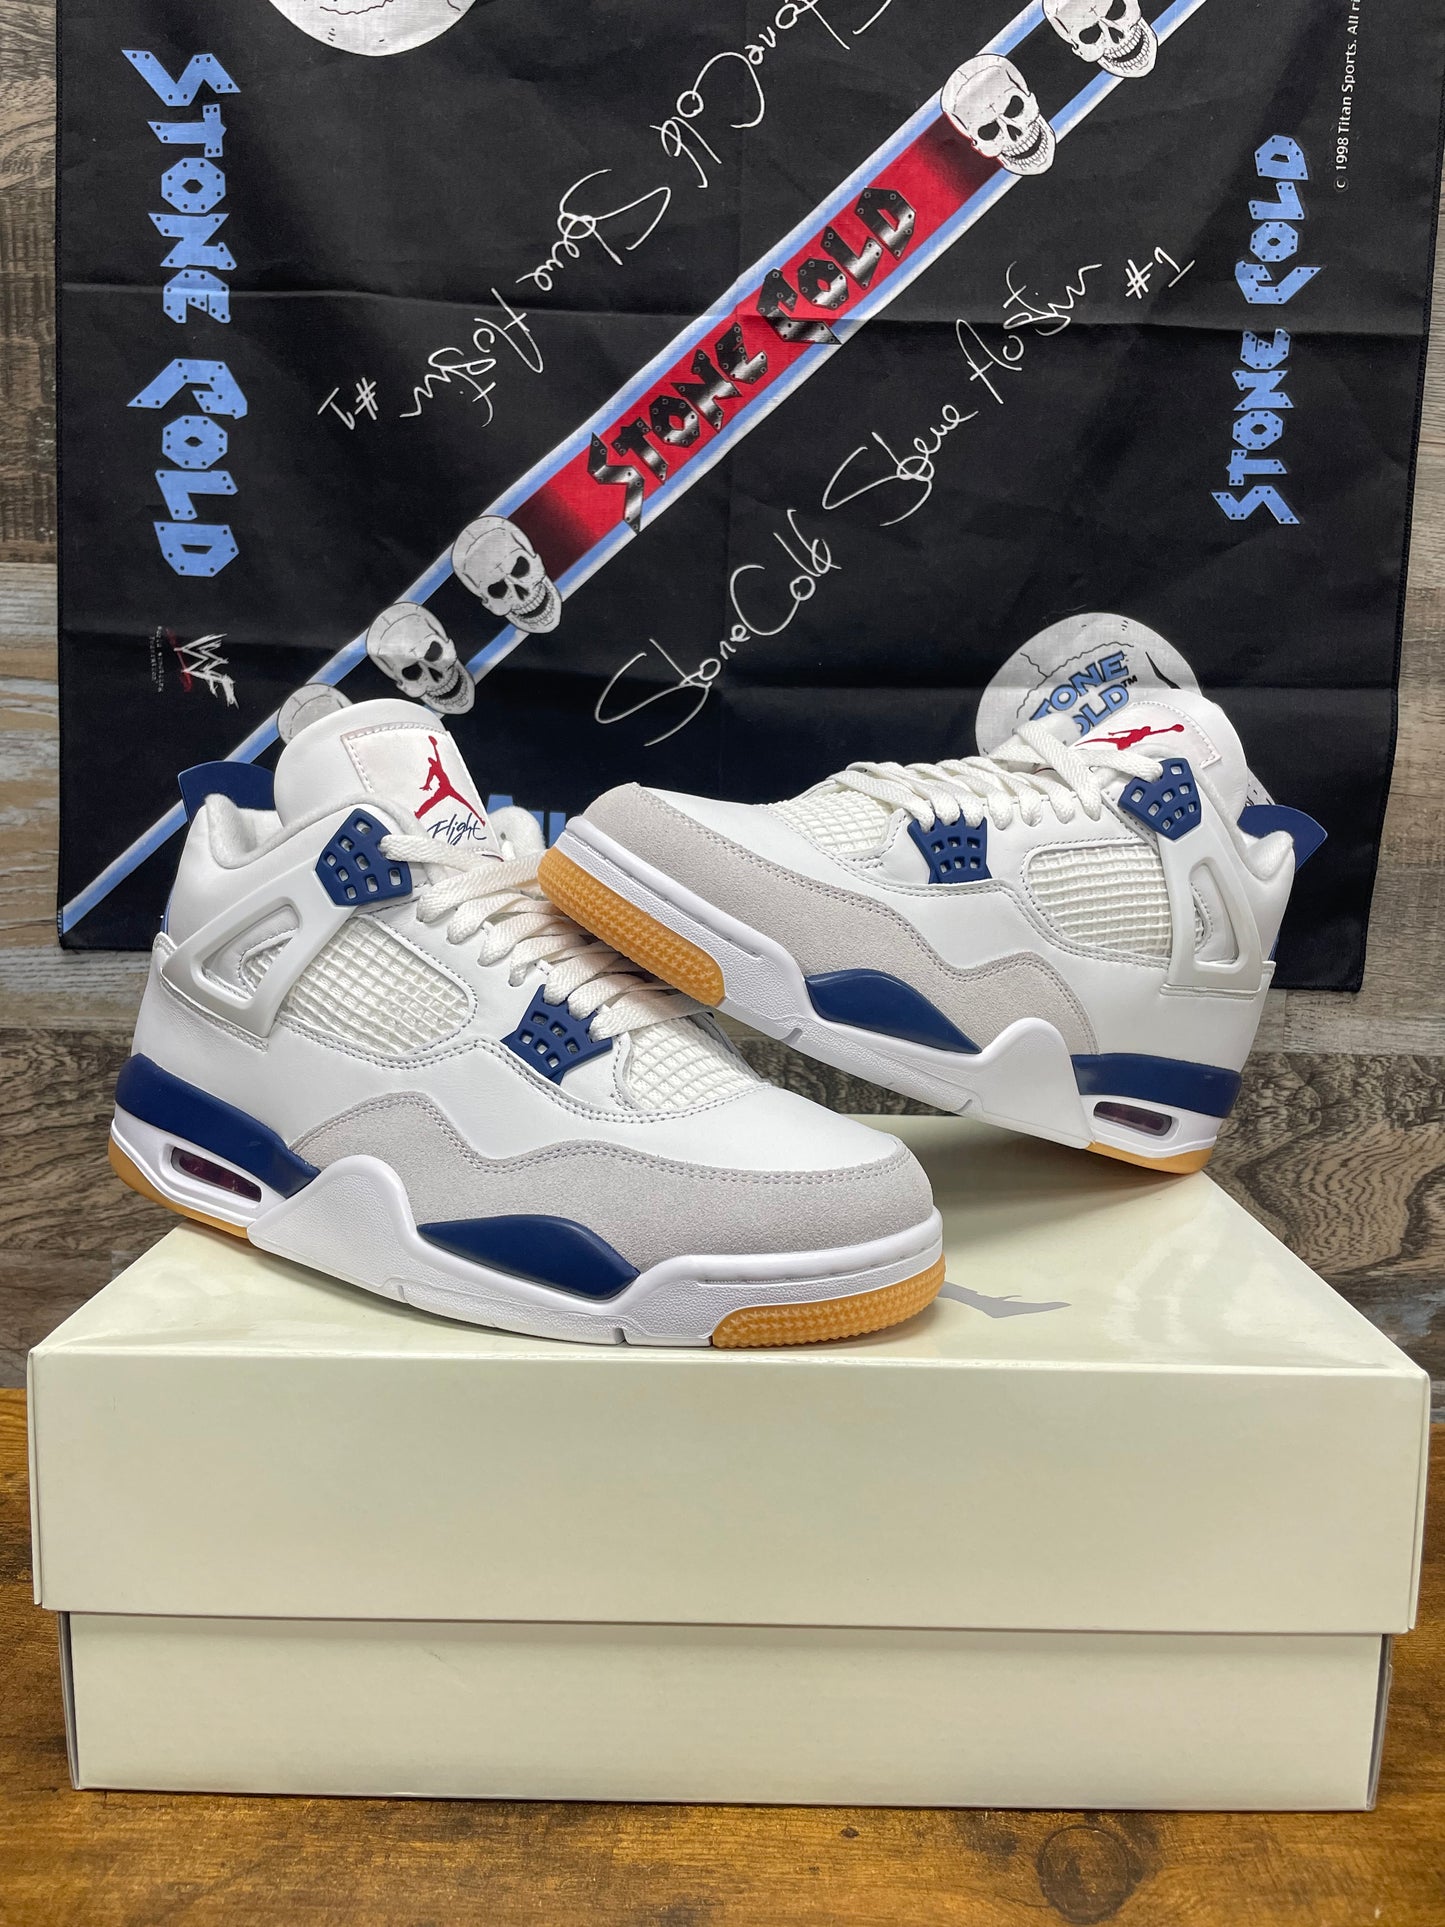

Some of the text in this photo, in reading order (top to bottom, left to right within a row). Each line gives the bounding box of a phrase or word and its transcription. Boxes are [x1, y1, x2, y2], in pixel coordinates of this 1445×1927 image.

[1347, 15, 1359, 35] All
[1341, 39, 1357, 92] Sports.
[1338, 96, 1352, 133] Titan
[1336, 137, 1349, 170] 1998
[1124, 247, 1195, 299] #1
[121, 49, 248, 577] STONE COLD
[1211, 134, 1322, 525] STONE COLD
[587, 187, 916, 534] STONE COLD
[318, 377, 379, 430] #1
[1029, 650, 1129, 720] TONE
[1072, 683, 1129, 737] LD
[427, 813, 487, 846] Flight
